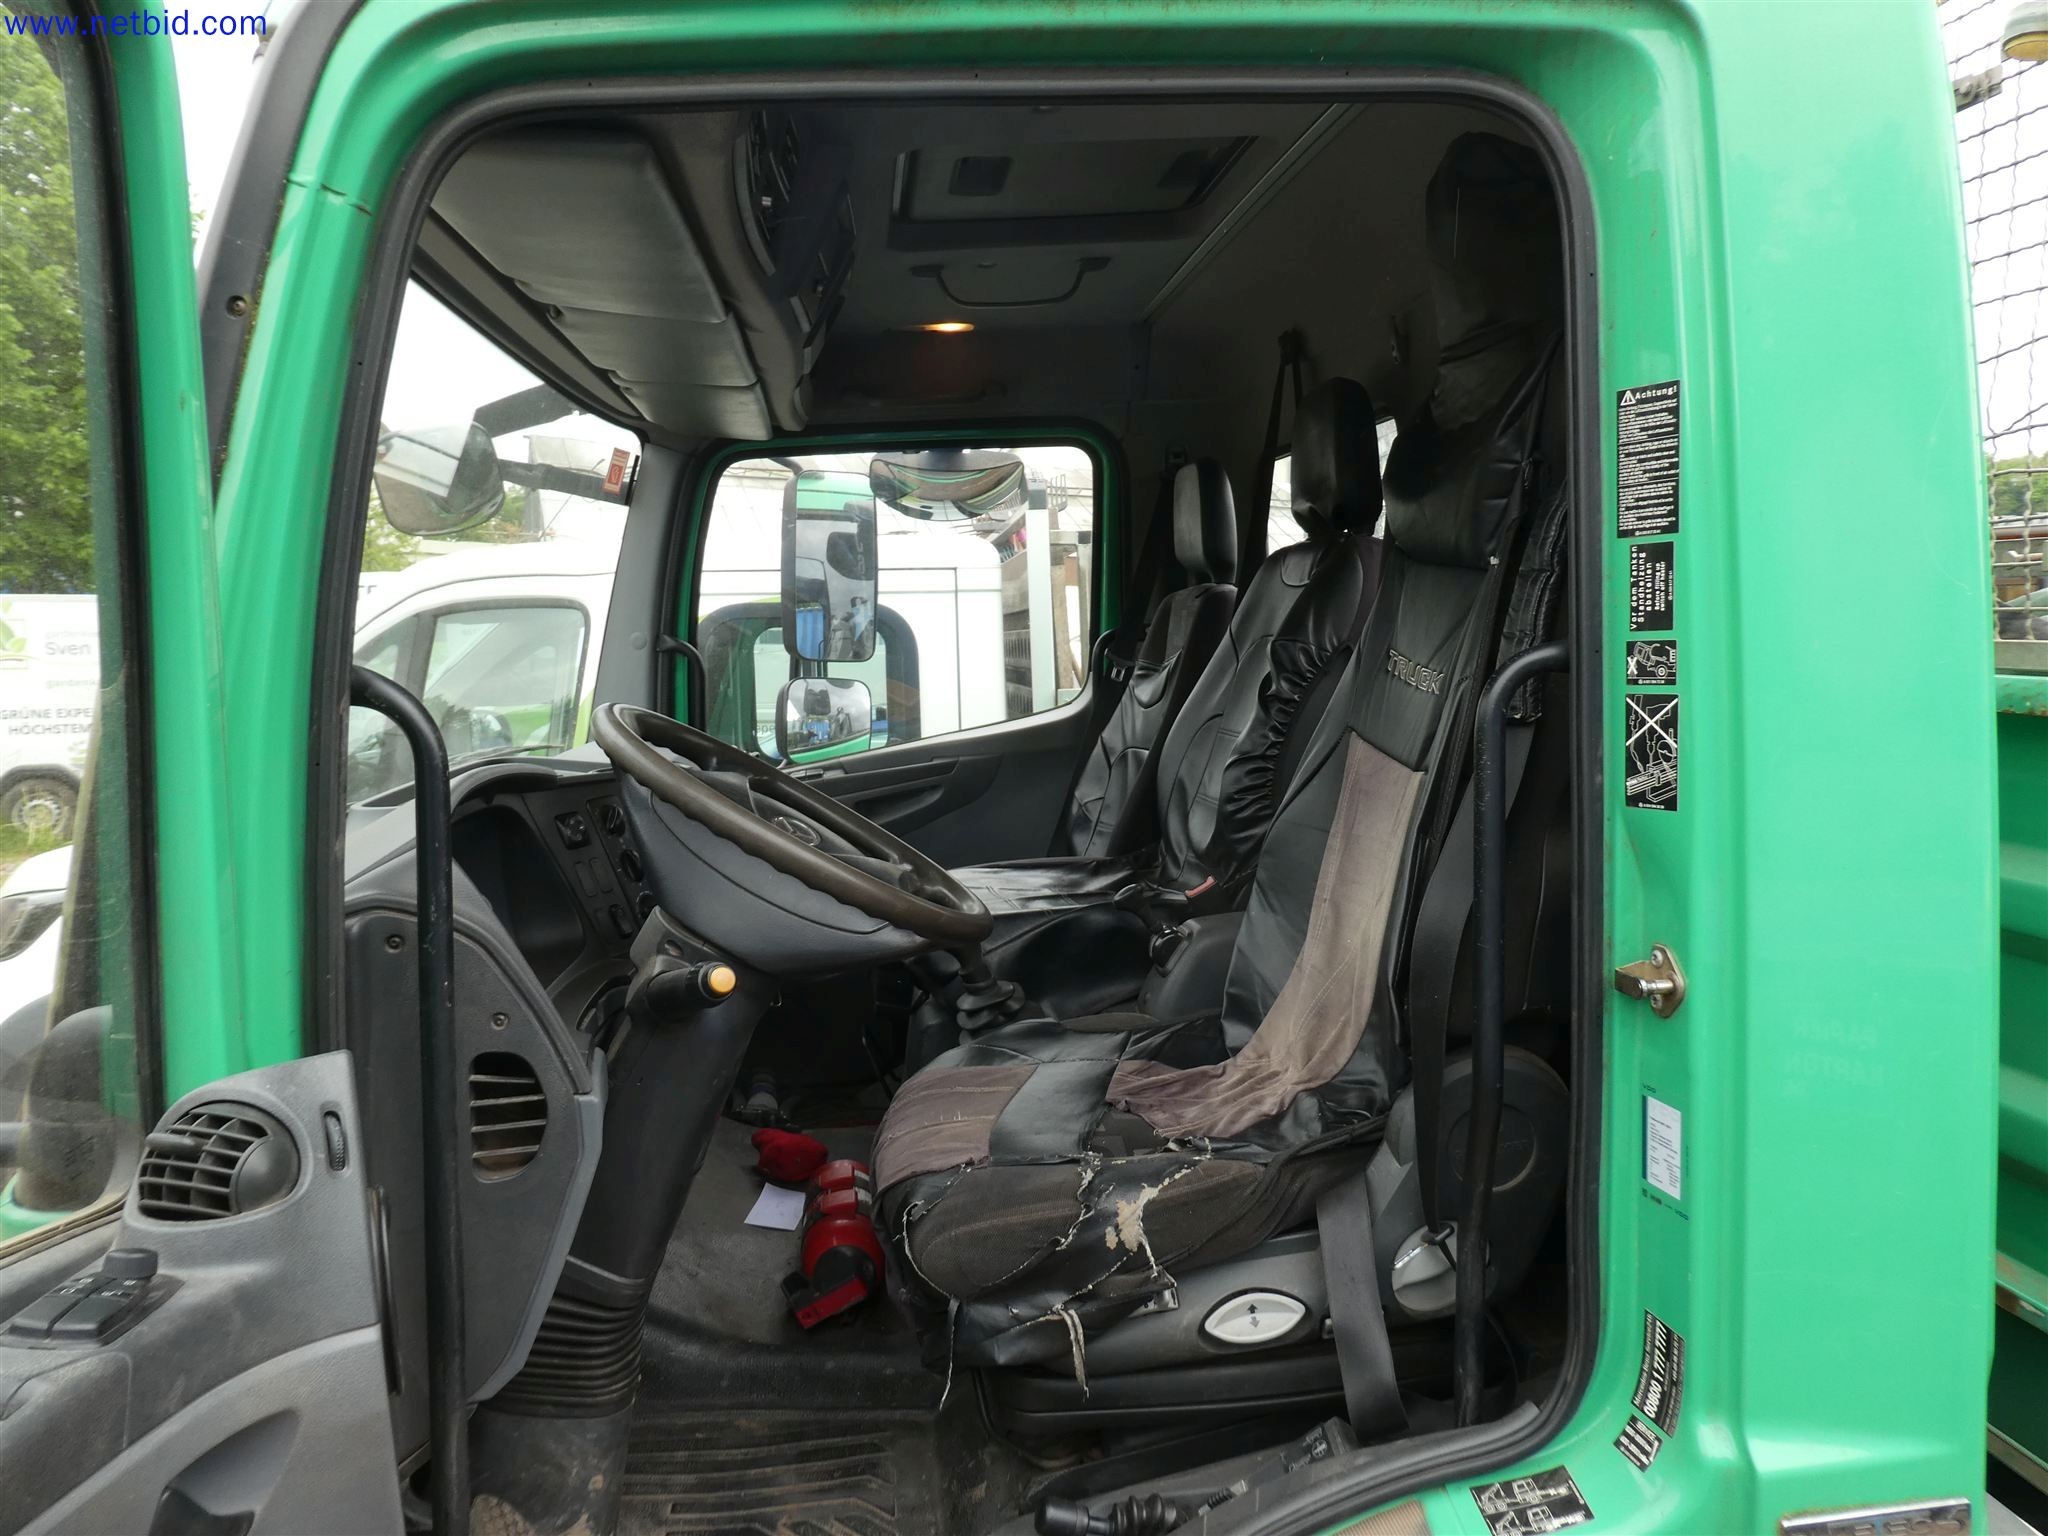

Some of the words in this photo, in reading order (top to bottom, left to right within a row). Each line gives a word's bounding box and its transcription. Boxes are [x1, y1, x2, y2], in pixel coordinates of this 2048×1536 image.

[1635, 385, 1678, 400] Achtung!
[45, 641, 92, 656] Sven
[1387, 649, 1445, 695] TRUCK
[1643, 1379, 1662, 1419] 00800
